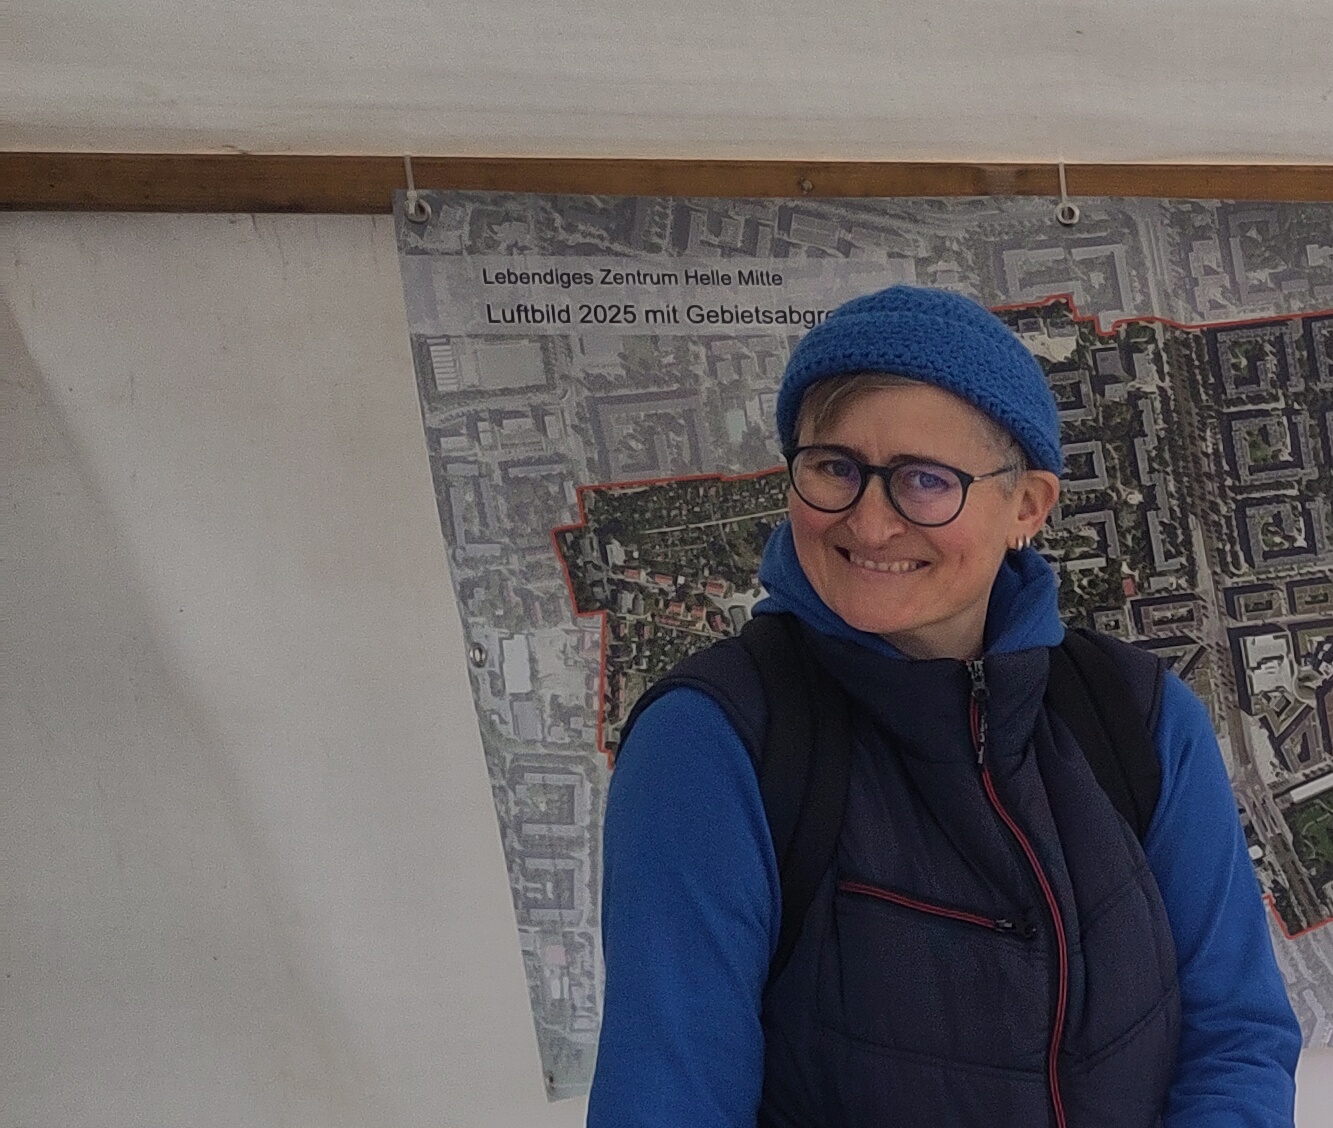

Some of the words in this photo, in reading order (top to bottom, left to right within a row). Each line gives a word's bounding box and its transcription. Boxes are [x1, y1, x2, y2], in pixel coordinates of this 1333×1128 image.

[483, 267, 594, 289] Lebendiges
[600, 268, 679, 287] Zentrum
[684, 269, 732, 287] Helle
[737, 269, 783, 287] Mitte
[486, 303, 573, 325] Luftbild
[578, 304, 637, 325] 2025
[644, 304, 679, 325] mit
